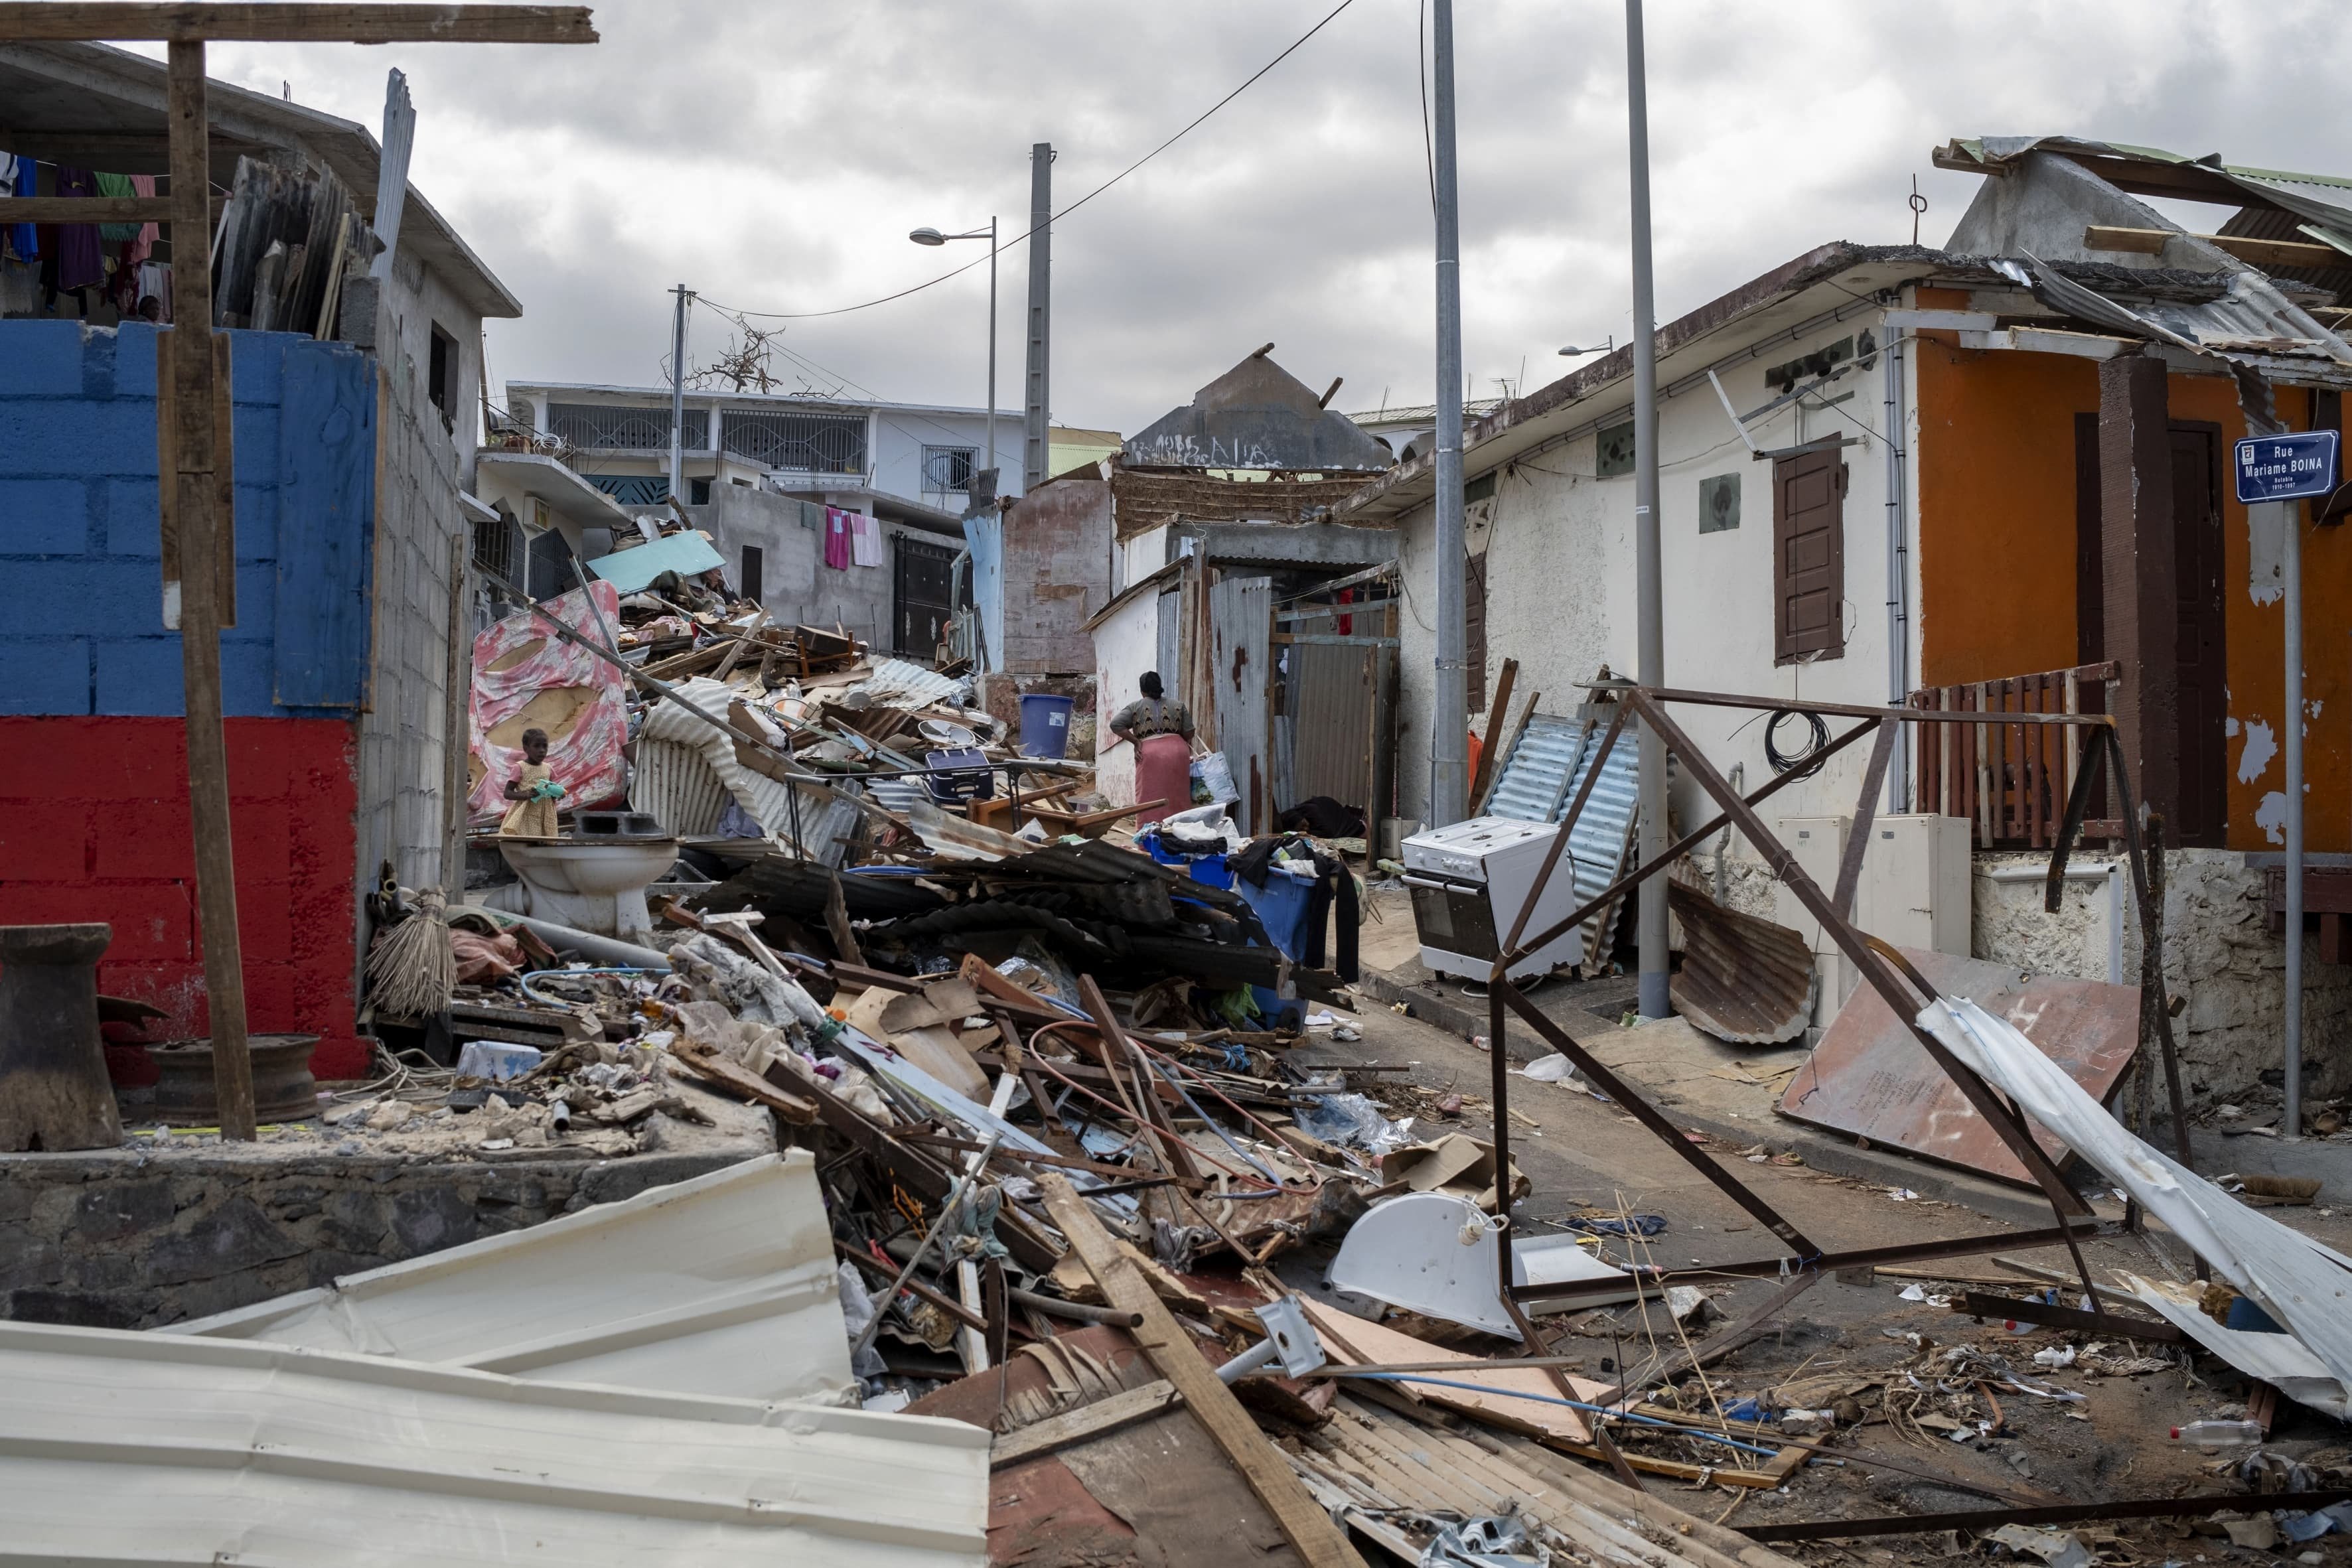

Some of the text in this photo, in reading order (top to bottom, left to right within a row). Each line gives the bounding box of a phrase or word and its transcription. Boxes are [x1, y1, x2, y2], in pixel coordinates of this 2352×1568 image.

[2274, 447, 2293, 458] Rue
[2246, 457, 2322, 477] Mariame BOINA
